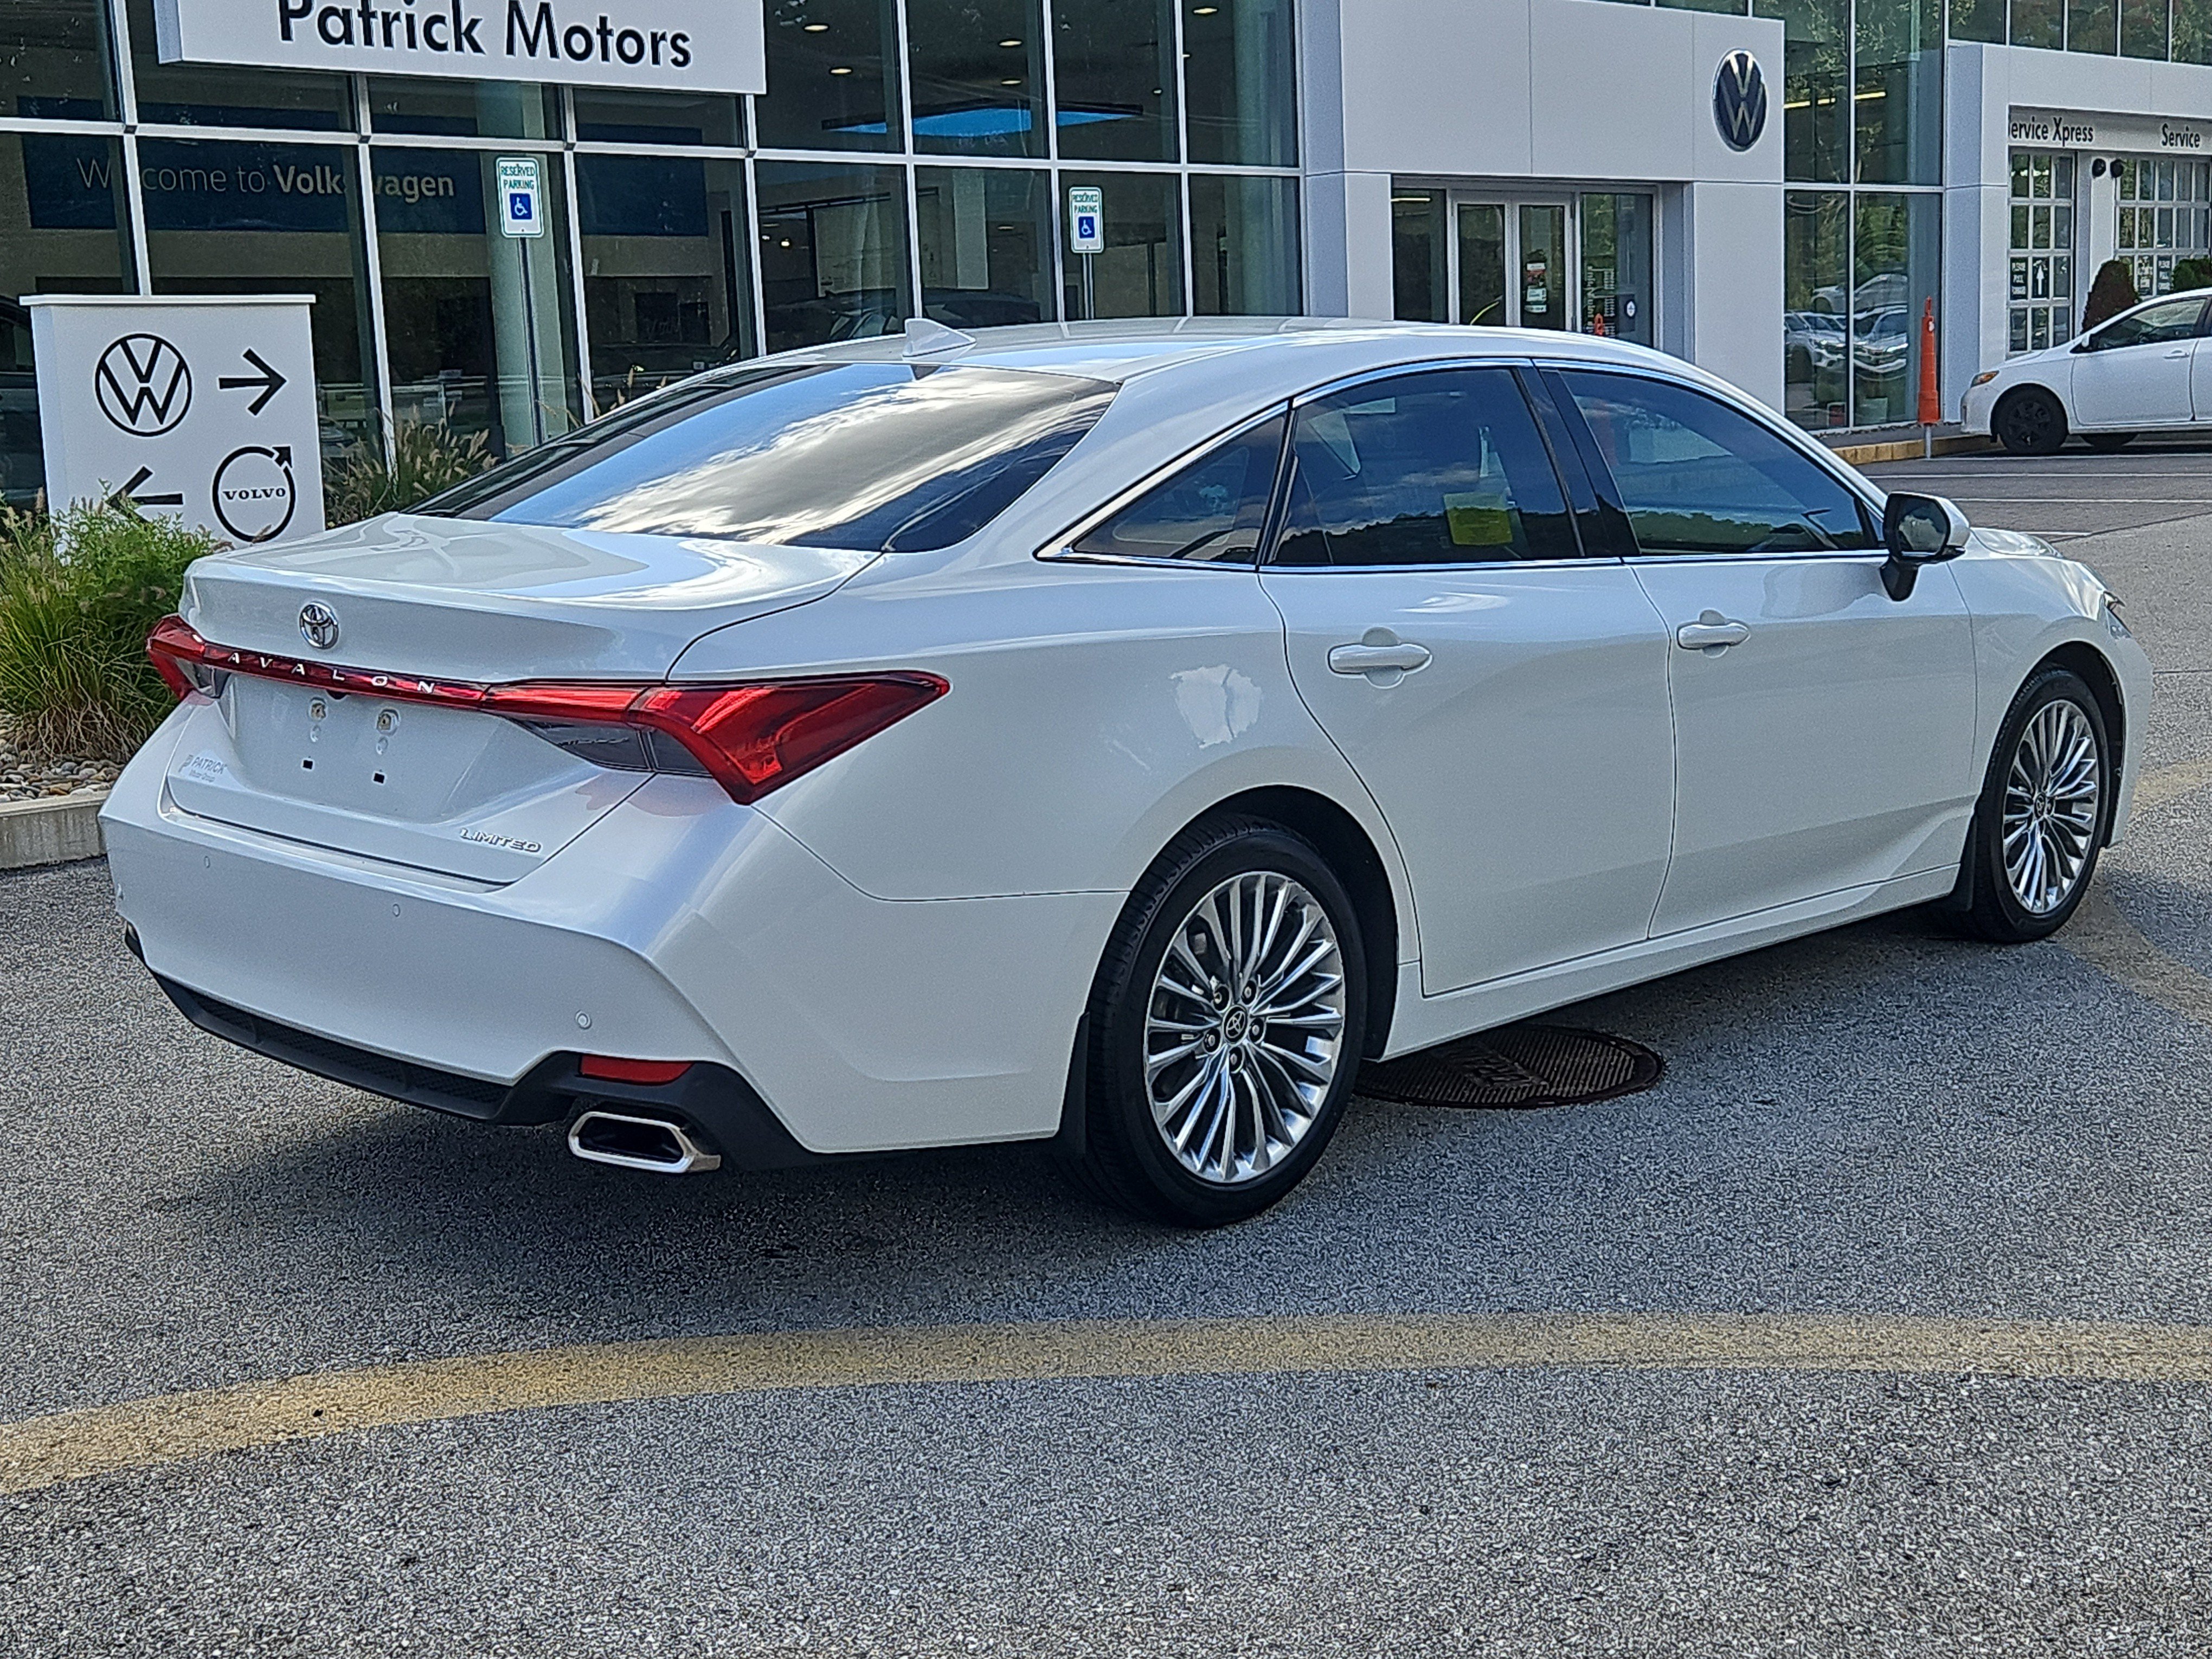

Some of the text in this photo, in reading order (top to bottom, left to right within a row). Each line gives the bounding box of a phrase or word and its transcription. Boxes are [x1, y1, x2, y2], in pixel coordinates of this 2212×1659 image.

[279, 0, 691, 67] Patrick Motors
[2008, 116, 2093, 147] ervice Xpress
[2162, 123, 2201, 148] Service
[77, 158, 454, 203] Wcome to Volkagen
[500, 165, 536, 176] RESERVED
[503, 179, 535, 190] PARKING
[222, 488, 286, 499] VOLVO
[228, 652, 435, 693] AVALON
[460, 827, 542, 852] LIMITED
